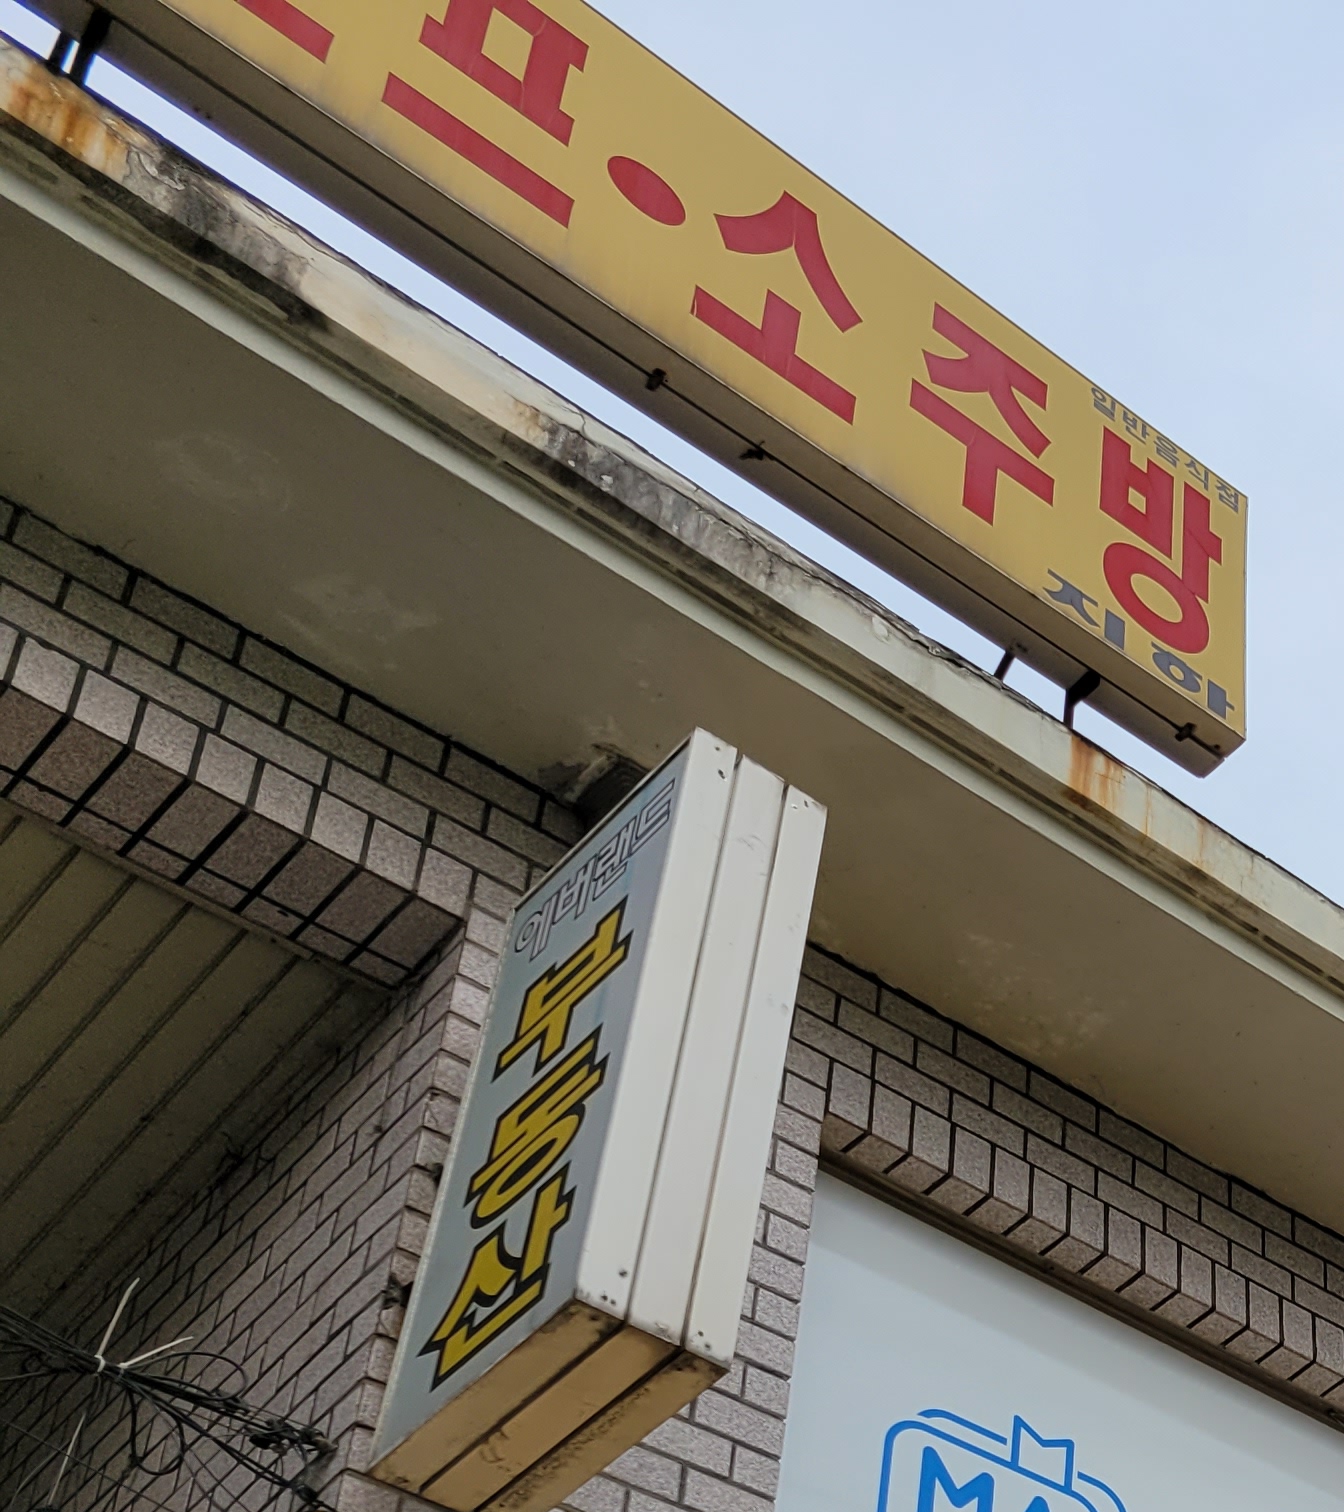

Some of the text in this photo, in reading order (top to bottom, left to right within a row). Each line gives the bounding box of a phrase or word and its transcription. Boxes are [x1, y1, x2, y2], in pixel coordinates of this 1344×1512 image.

[236, 0, 1222, 655] 프·소주방
[1091, 386, 1239, 514] 일반음식점
[1047, 569, 1235, 720] 지하
[513, 780, 677, 962] 에버랜드
[419, 894, 634, 1392] 부동산
